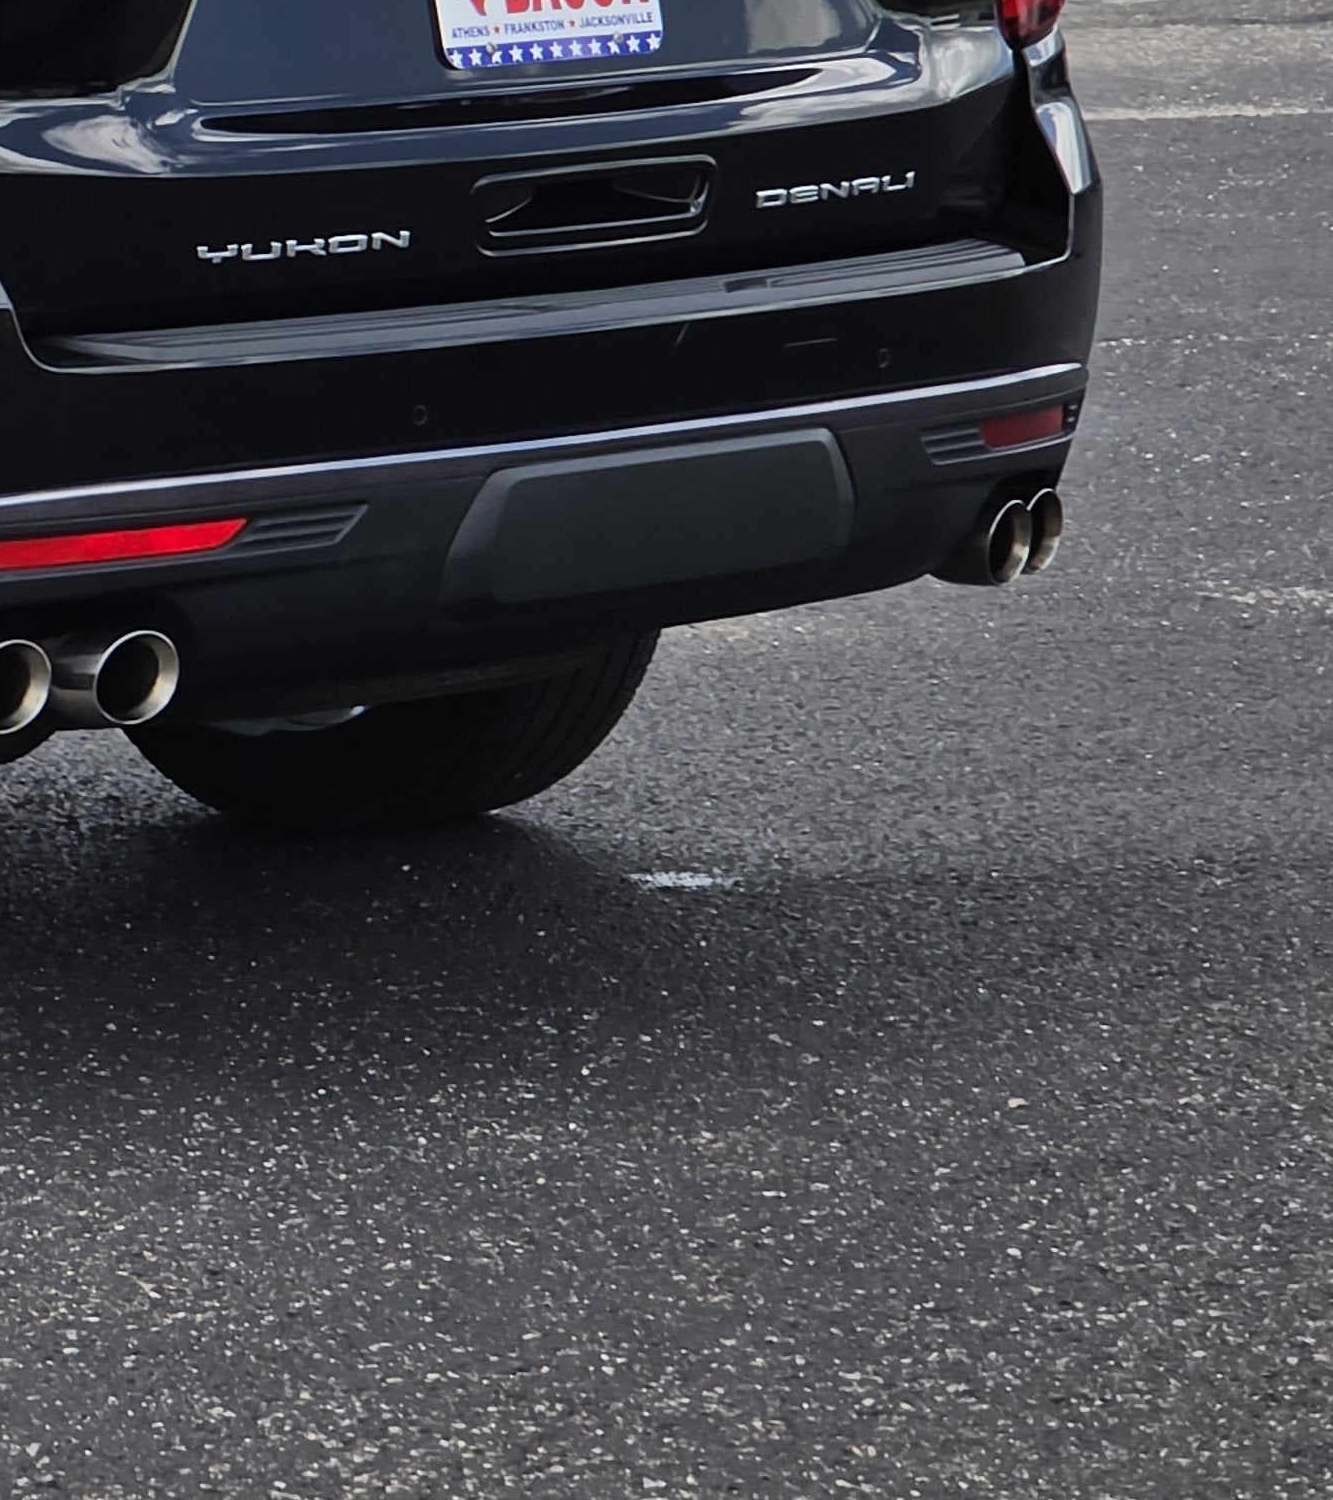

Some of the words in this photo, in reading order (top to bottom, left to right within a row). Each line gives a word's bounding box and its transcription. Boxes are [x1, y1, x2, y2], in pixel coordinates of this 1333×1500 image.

[451, 25, 491, 40] ATHENS
[504, 18, 566, 35] FRANKSTON
[579, 10, 655, 30] JACKSONVILLE
[755, 170, 916, 209] DENALI
[196, 230, 411, 264] YUKON
